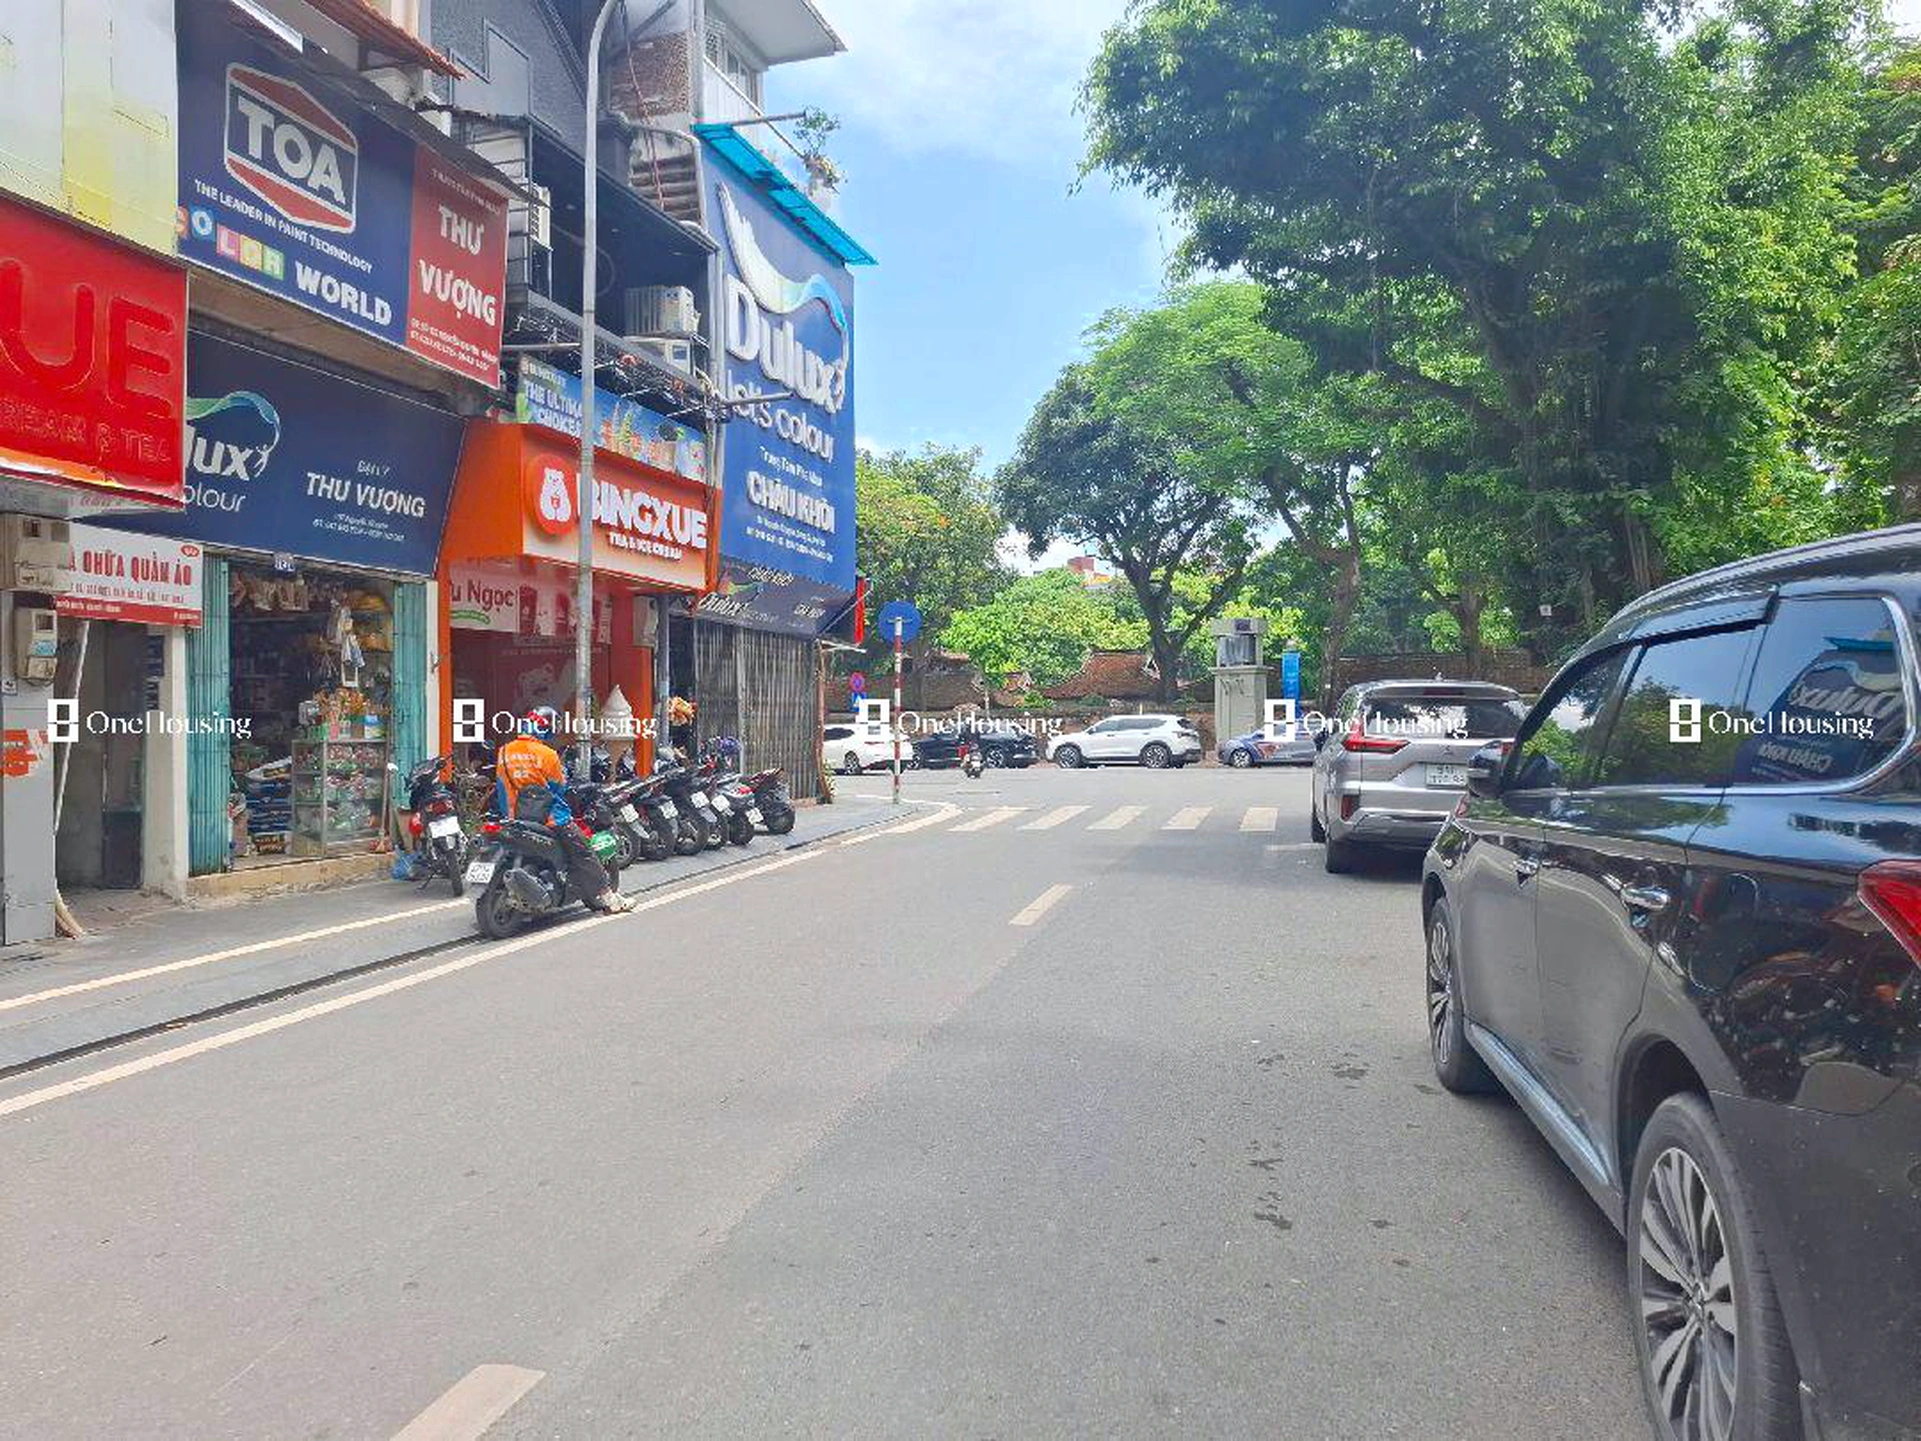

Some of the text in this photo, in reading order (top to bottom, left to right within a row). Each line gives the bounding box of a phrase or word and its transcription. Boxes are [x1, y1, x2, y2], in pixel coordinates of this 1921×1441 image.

[238, 95, 346, 205] TOA
[194, 179, 374, 276] THE LEADER IN PAINT TECHNOLOGY
[295, 260, 392, 326] WORLD
[419, 258, 496, 326] VƯỢNG
[726, 274, 836, 413] Dulux
[776, 408, 834, 463] colour
[356, 483, 427, 518] VƯỢNG
[468, 580, 515, 612] Ngọc
